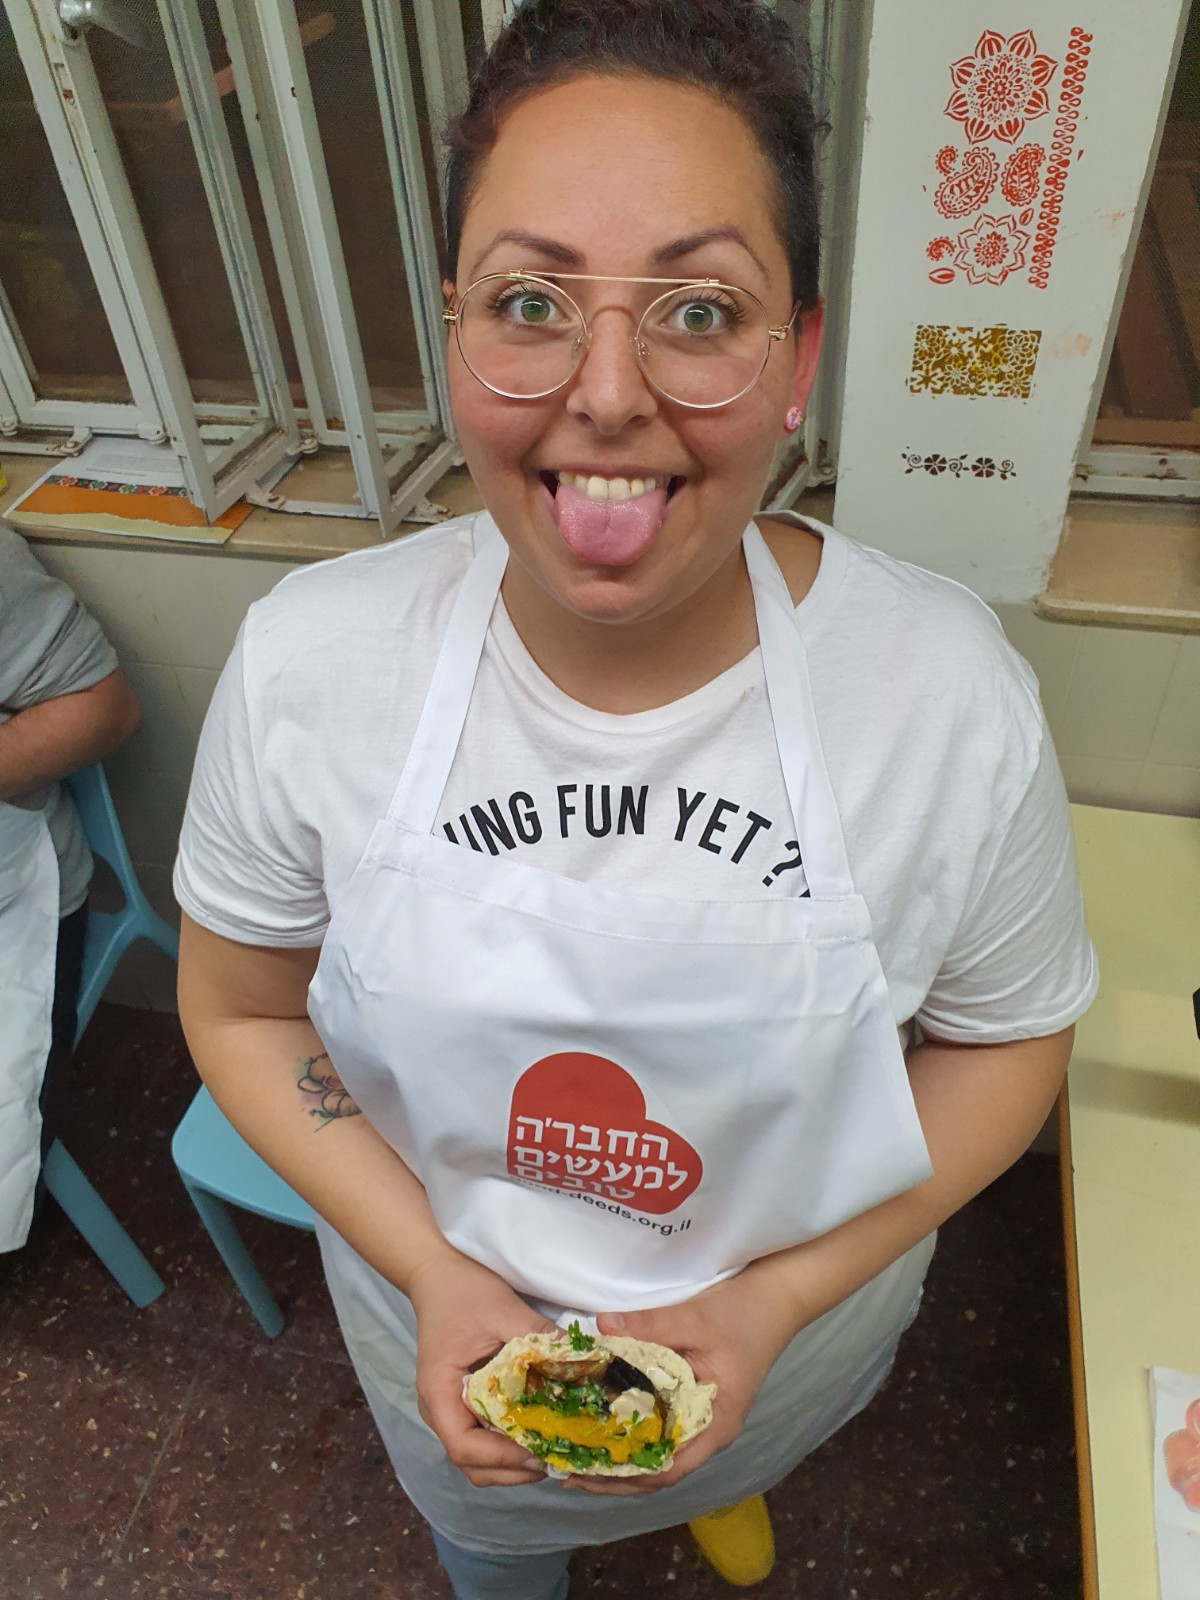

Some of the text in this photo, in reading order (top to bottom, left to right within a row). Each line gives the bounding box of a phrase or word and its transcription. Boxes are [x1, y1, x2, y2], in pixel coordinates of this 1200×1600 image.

[556, 783, 649, 839] FUN
[515, 1114, 669, 1162] החבר'ה
[513, 1145, 689, 1192] למעשים
[513, 1164, 636, 1200] טובים
